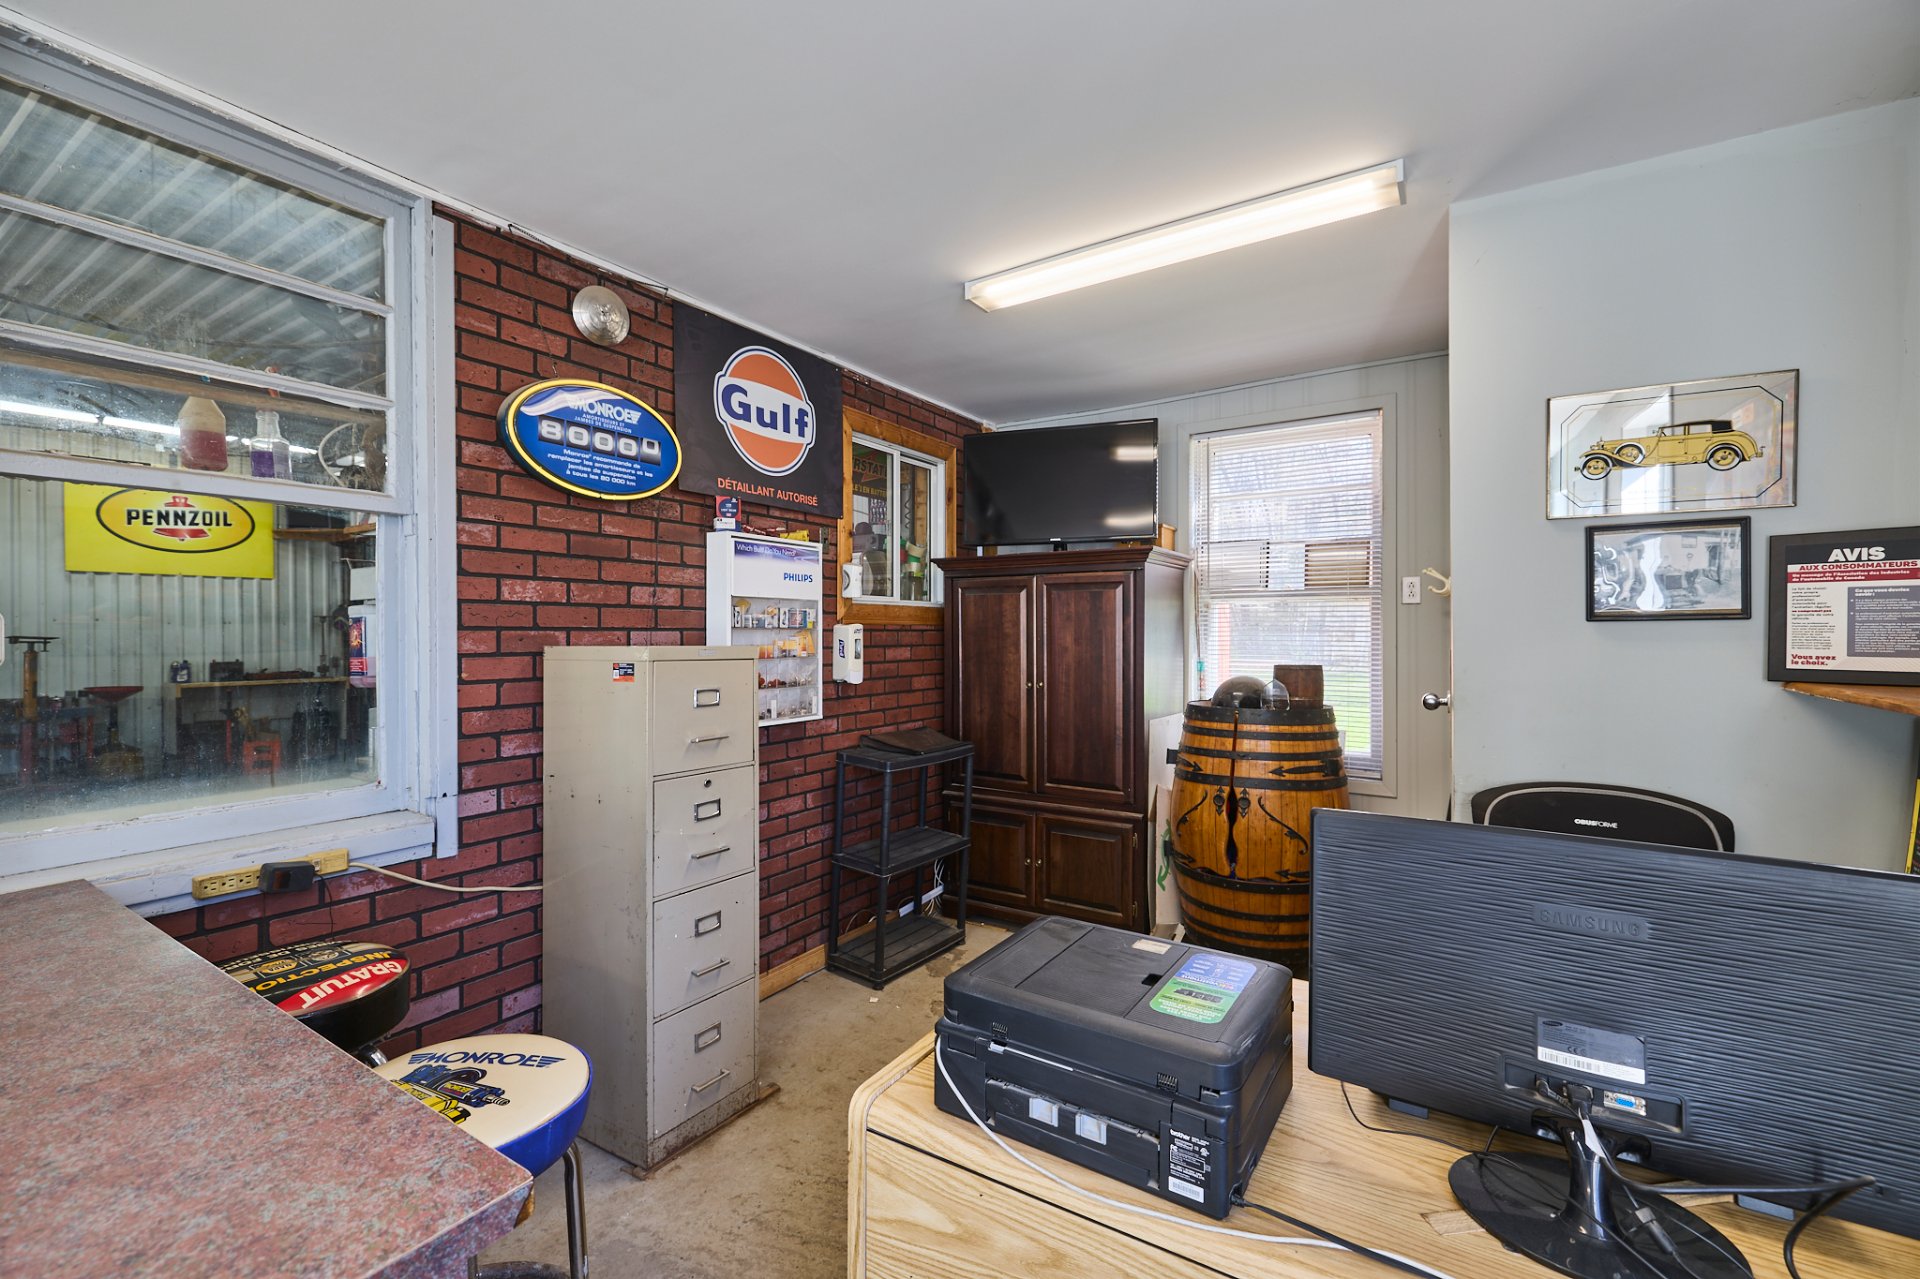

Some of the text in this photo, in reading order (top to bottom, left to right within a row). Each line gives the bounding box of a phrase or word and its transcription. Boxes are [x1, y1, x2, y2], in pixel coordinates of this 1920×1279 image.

[575, 399, 635, 425] MONROE
[722, 384, 808, 438] Gulf
[548, 453, 582, 464] remplacer
[594, 463, 635, 474] amortisseurs
[593, 456, 632, 467] recommande
[568, 463, 591, 472] jambes
[602, 470, 636, 480] suspension
[718, 476, 818, 506] DÉTAILLANT AUTORISÉ
[126, 509, 232, 526] PENNZOIL
[736, 544, 753, 552] Which
[1828, 546, 1886, 562] AVIS
[1821, 561, 1918, 570] CONSOMMATEURS
[784, 573, 813, 582] PHILIPS
[1574, 819, 1618, 828] OBUSFORME
[1540, 909, 1640, 937] SAMSUNG
[299, 960, 402, 1009] GRATUIT
[418, 1052, 548, 1068] MONROE
[1170, 1129, 1190, 1140] brother
